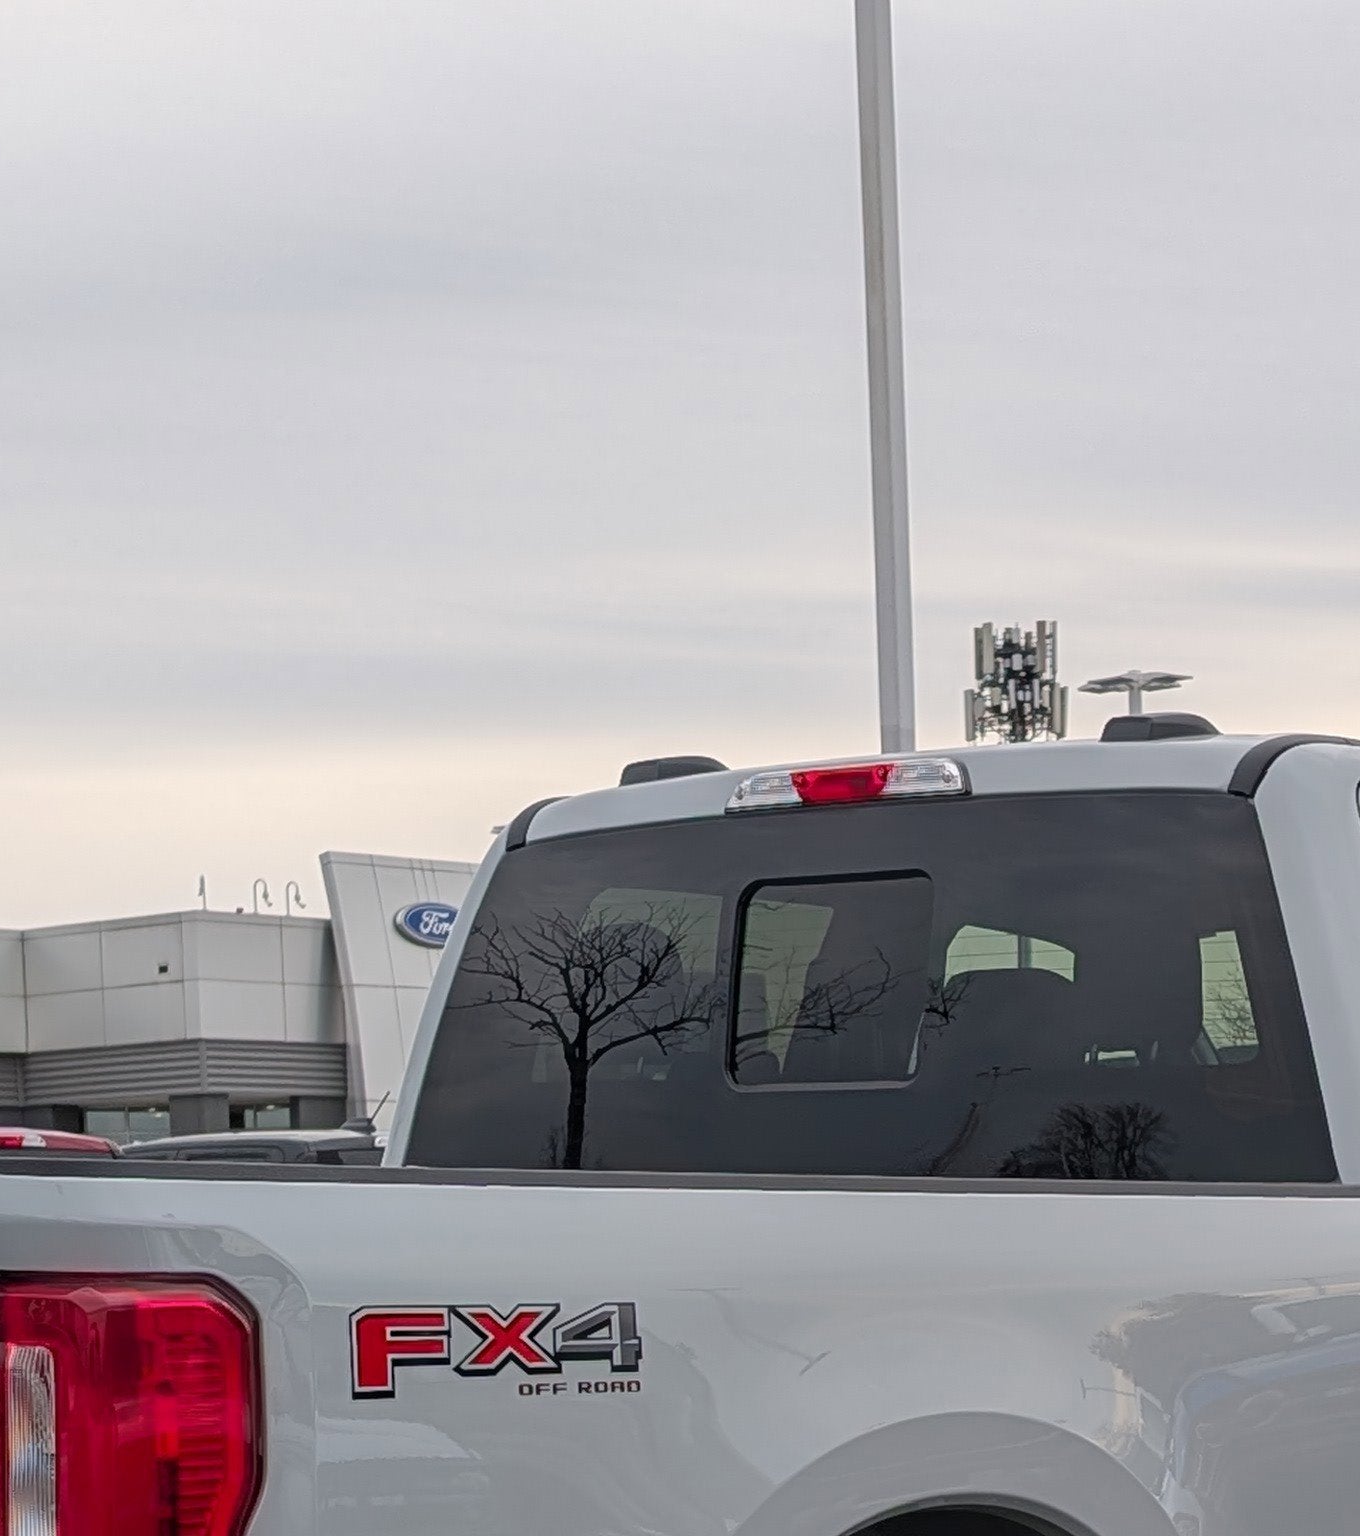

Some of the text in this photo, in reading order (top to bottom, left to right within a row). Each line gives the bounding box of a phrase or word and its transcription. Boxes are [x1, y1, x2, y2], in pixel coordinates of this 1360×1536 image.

[420, 910, 453, 935] For
[349, 1302, 642, 1400] FX4
[518, 1380, 641, 1396] OFF ROAD
